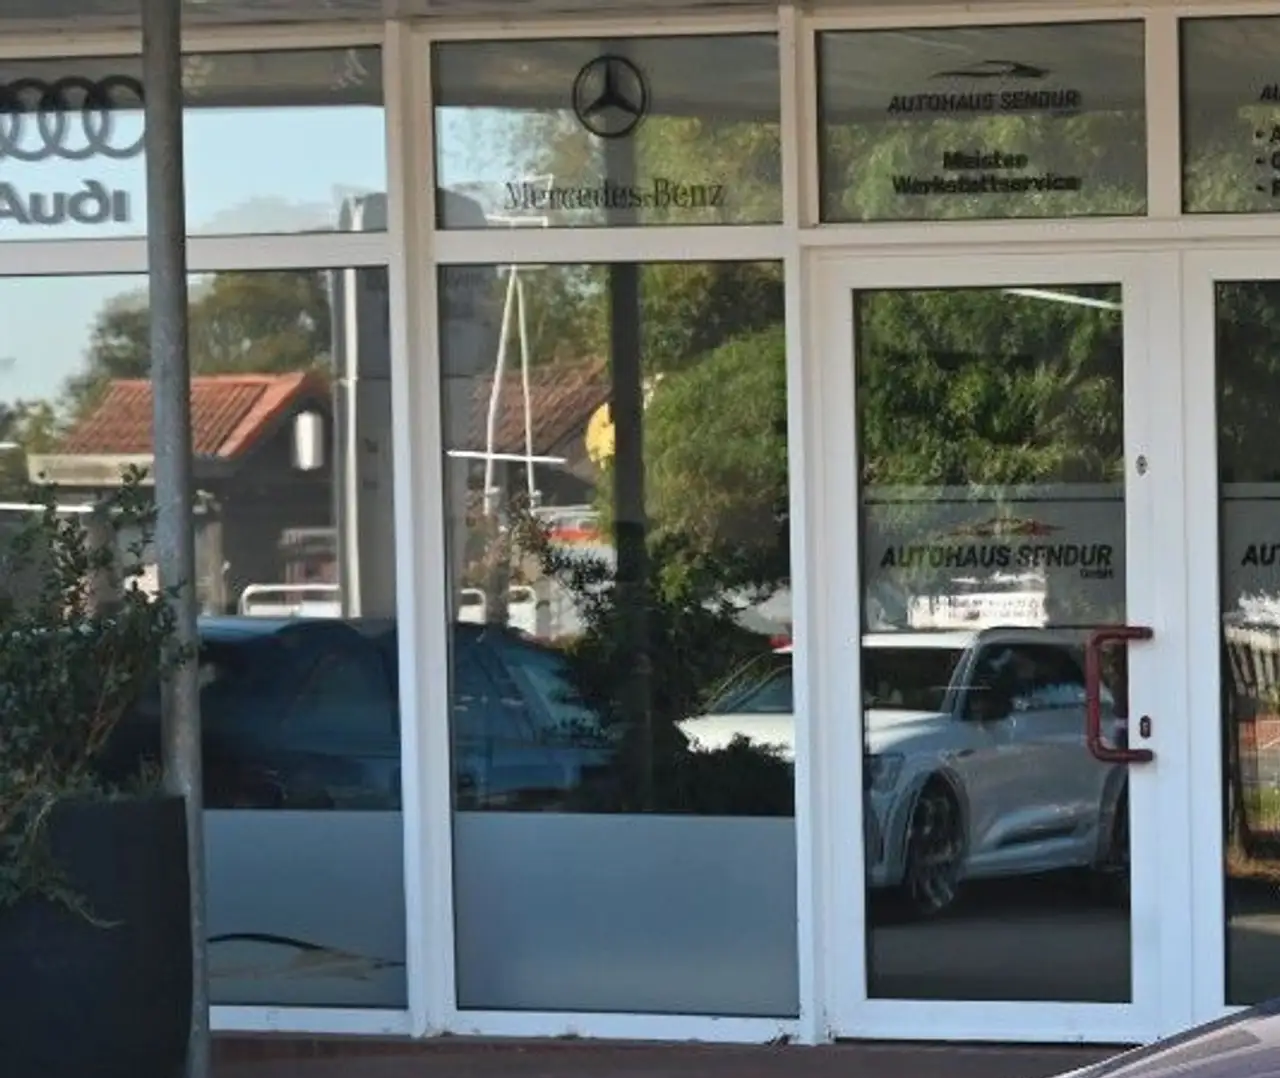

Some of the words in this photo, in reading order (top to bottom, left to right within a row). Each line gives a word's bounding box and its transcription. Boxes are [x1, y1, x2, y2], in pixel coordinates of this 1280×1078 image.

[887, 92, 993, 114] AUTOHAUS
[1000, 89, 1082, 111] SENDUR
[504, 177, 724, 210] Mercedes-Benz
[880, 545, 1012, 569] AUTOHAUS
[1016, 543, 1114, 567] SENDUR
